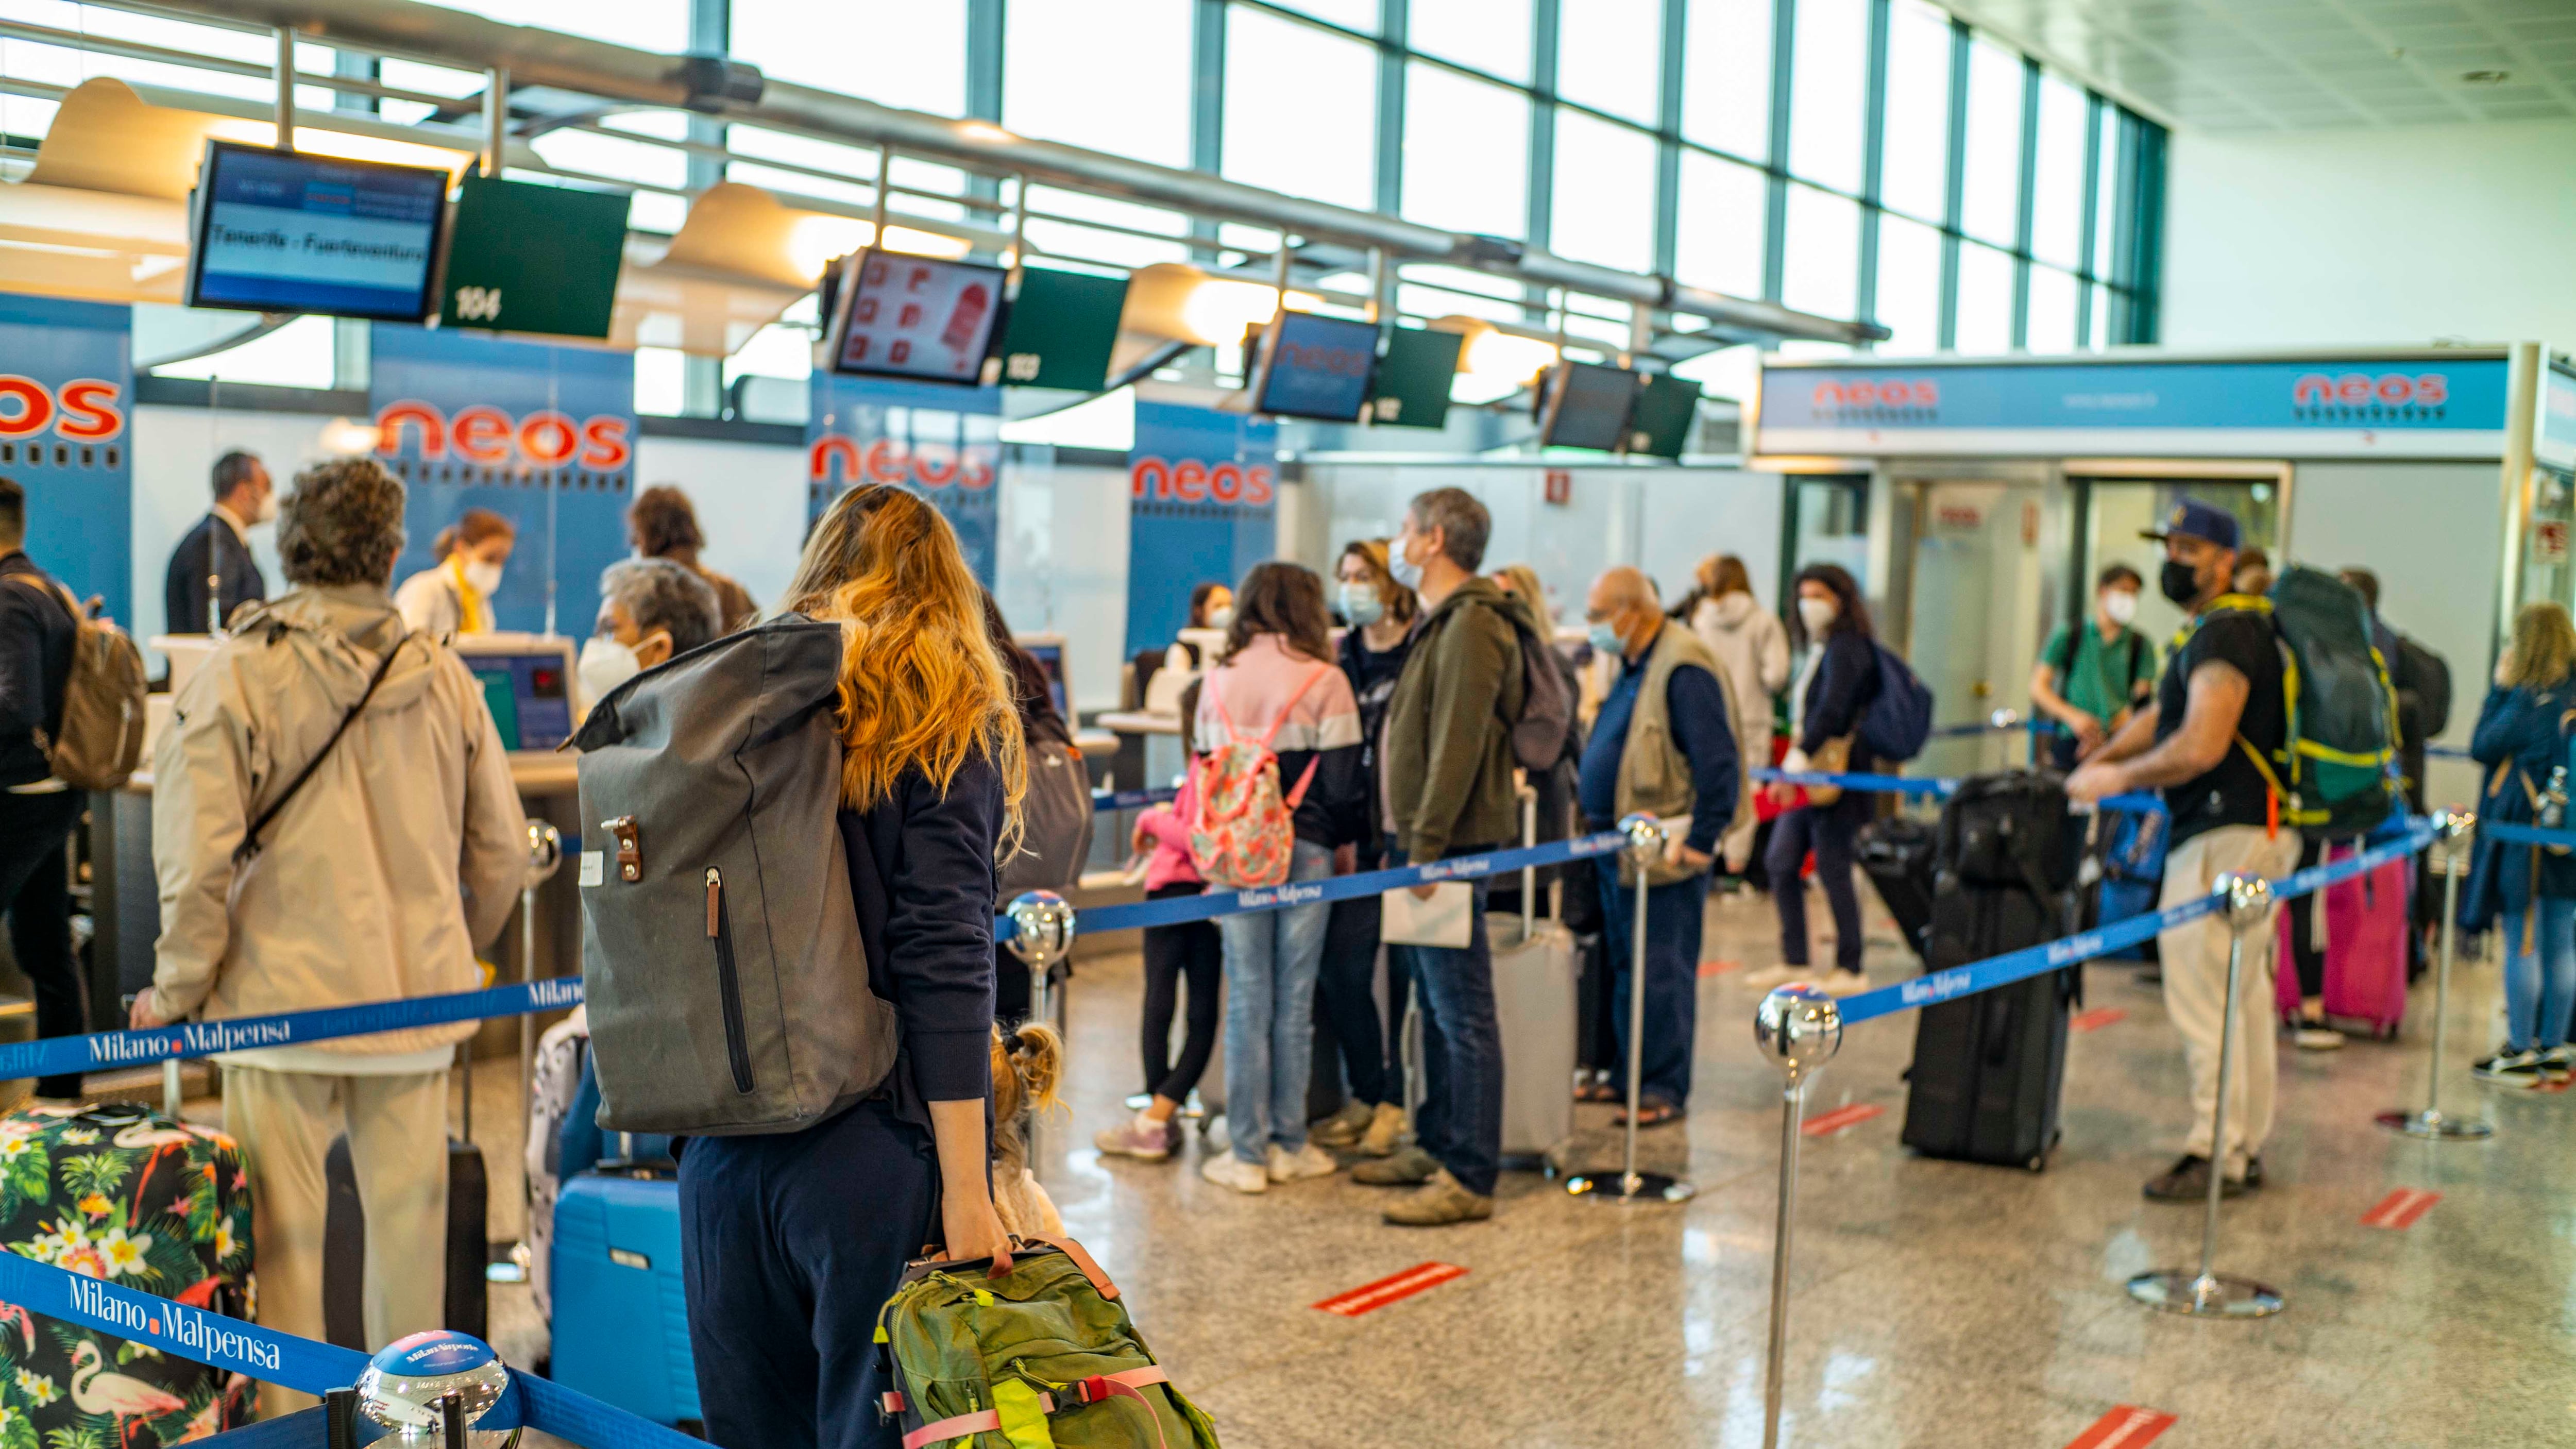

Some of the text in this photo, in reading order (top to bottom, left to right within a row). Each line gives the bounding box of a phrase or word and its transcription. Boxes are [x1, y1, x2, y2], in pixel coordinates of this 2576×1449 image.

[455, 285, 502, 321] 104
[1811, 378, 1939, 408] neos
[2294, 373, 2448, 407] neos
[375, 399, 632, 473] neos
[810, 433, 995, 490] neos
[1130, 455, 1274, 505] neos
[529, 979, 583, 1007] Milan
[89, 1020, 290, 1063] Milano Malpensa
[67, 1275, 146, 1330] Milano
[160, 1302, 280, 1370] Malpensa
